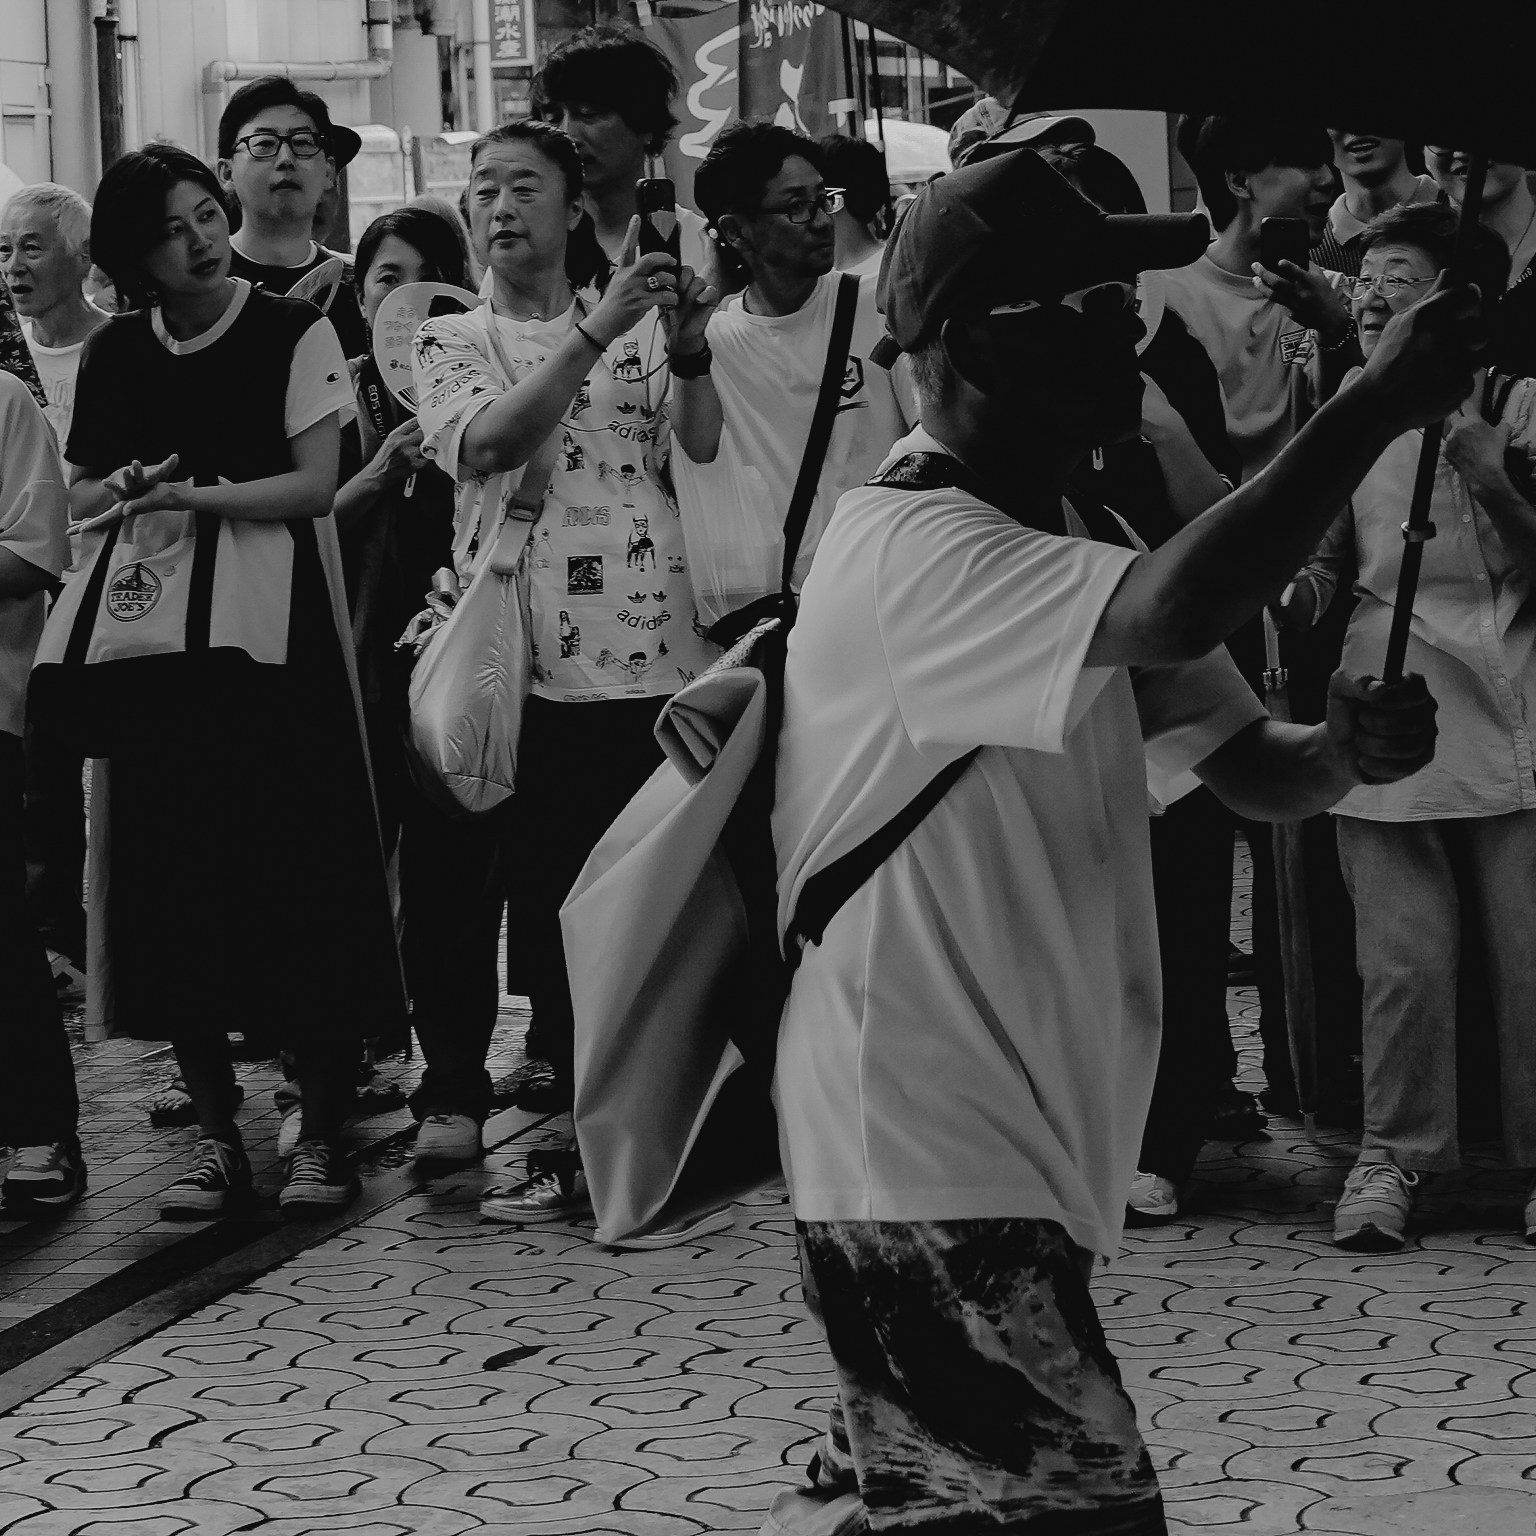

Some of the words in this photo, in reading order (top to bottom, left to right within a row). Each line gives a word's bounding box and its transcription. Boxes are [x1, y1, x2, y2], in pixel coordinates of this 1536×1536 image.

[368, 384, 381, 410] EOS
[111, 592, 154, 602] TRADER
[114, 602, 147, 613] JOE'S
